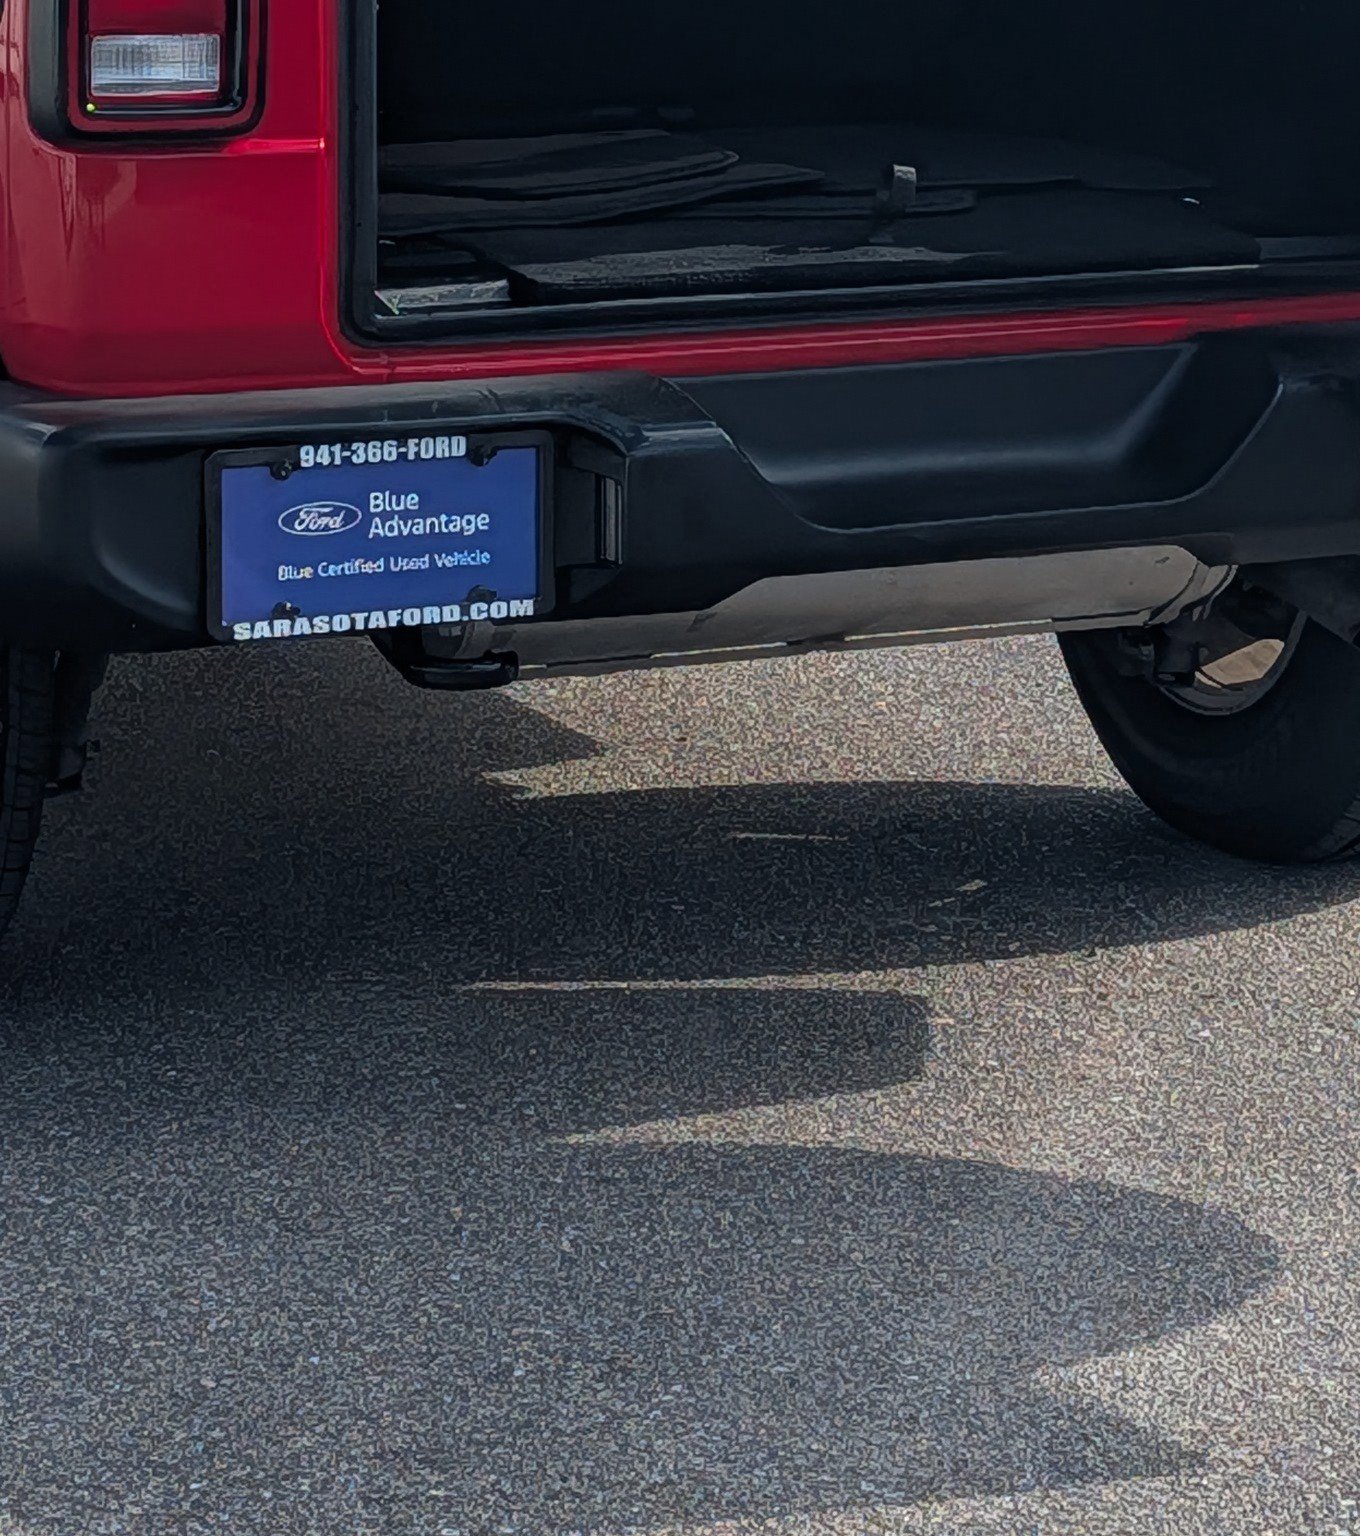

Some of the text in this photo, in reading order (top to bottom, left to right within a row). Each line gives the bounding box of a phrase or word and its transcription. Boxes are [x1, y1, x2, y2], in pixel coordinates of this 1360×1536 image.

[300, 436, 467, 467] 941-366-FORD
[369, 491, 420, 514] Blue
[294, 507, 346, 531] Ford
[368, 512, 490, 539] Advantage
[278, 549, 491, 581] Blue Certified Used Vehicle
[232, 598, 535, 641] SARASOTAFORD.COM
